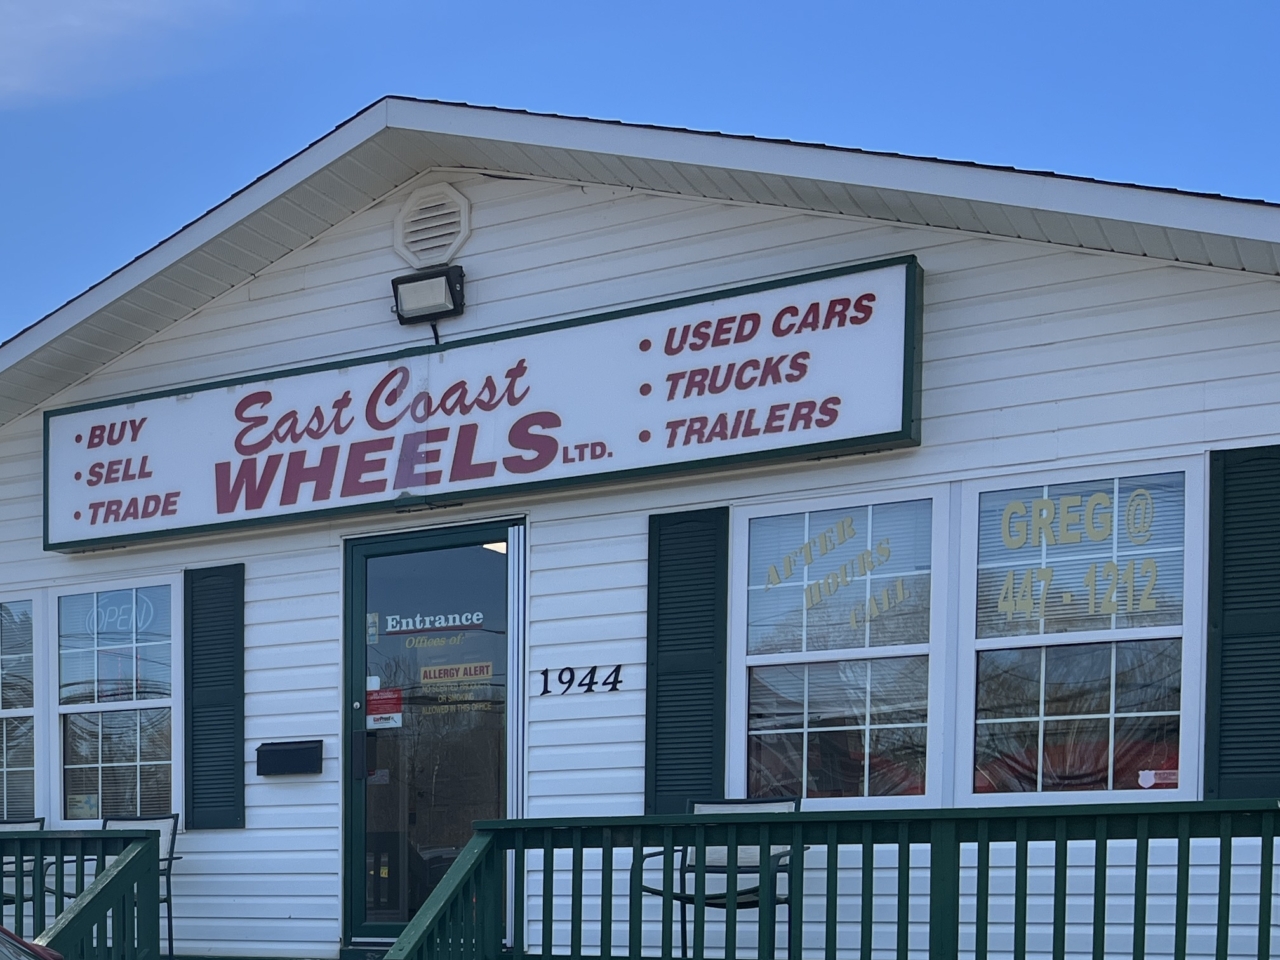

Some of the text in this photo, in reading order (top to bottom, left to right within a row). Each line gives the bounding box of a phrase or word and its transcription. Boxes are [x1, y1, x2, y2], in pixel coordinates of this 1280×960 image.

[664, 293, 876, 356] USED CARS
[665, 351, 811, 401] TRUCKS
[233, 358, 530, 456] East Coast
[665, 396, 841, 448] TRAILERS
[87, 417, 148, 449] BUY
[86, 455, 153, 487] SELL
[214, 411, 613, 515] WHEELS LTD.
[88, 491, 181, 525] TRADE
[1001, 488, 1154, 550] GREG @
[764, 516, 857, 593] AFTER
[804, 537, 891, 611] HOURS
[849, 577, 911, 630] CALL
[997, 567, 1053, 621] 447
[1083, 557, 1157, 616] 1212
[89, 603, 147, 632] OPEN
[385, 611, 484, 632] Entrance
[405, 635, 446, 649] Offices
[422, 665, 490, 680] ALLERGY ALERT
[540, 664, 623, 696] 1944
